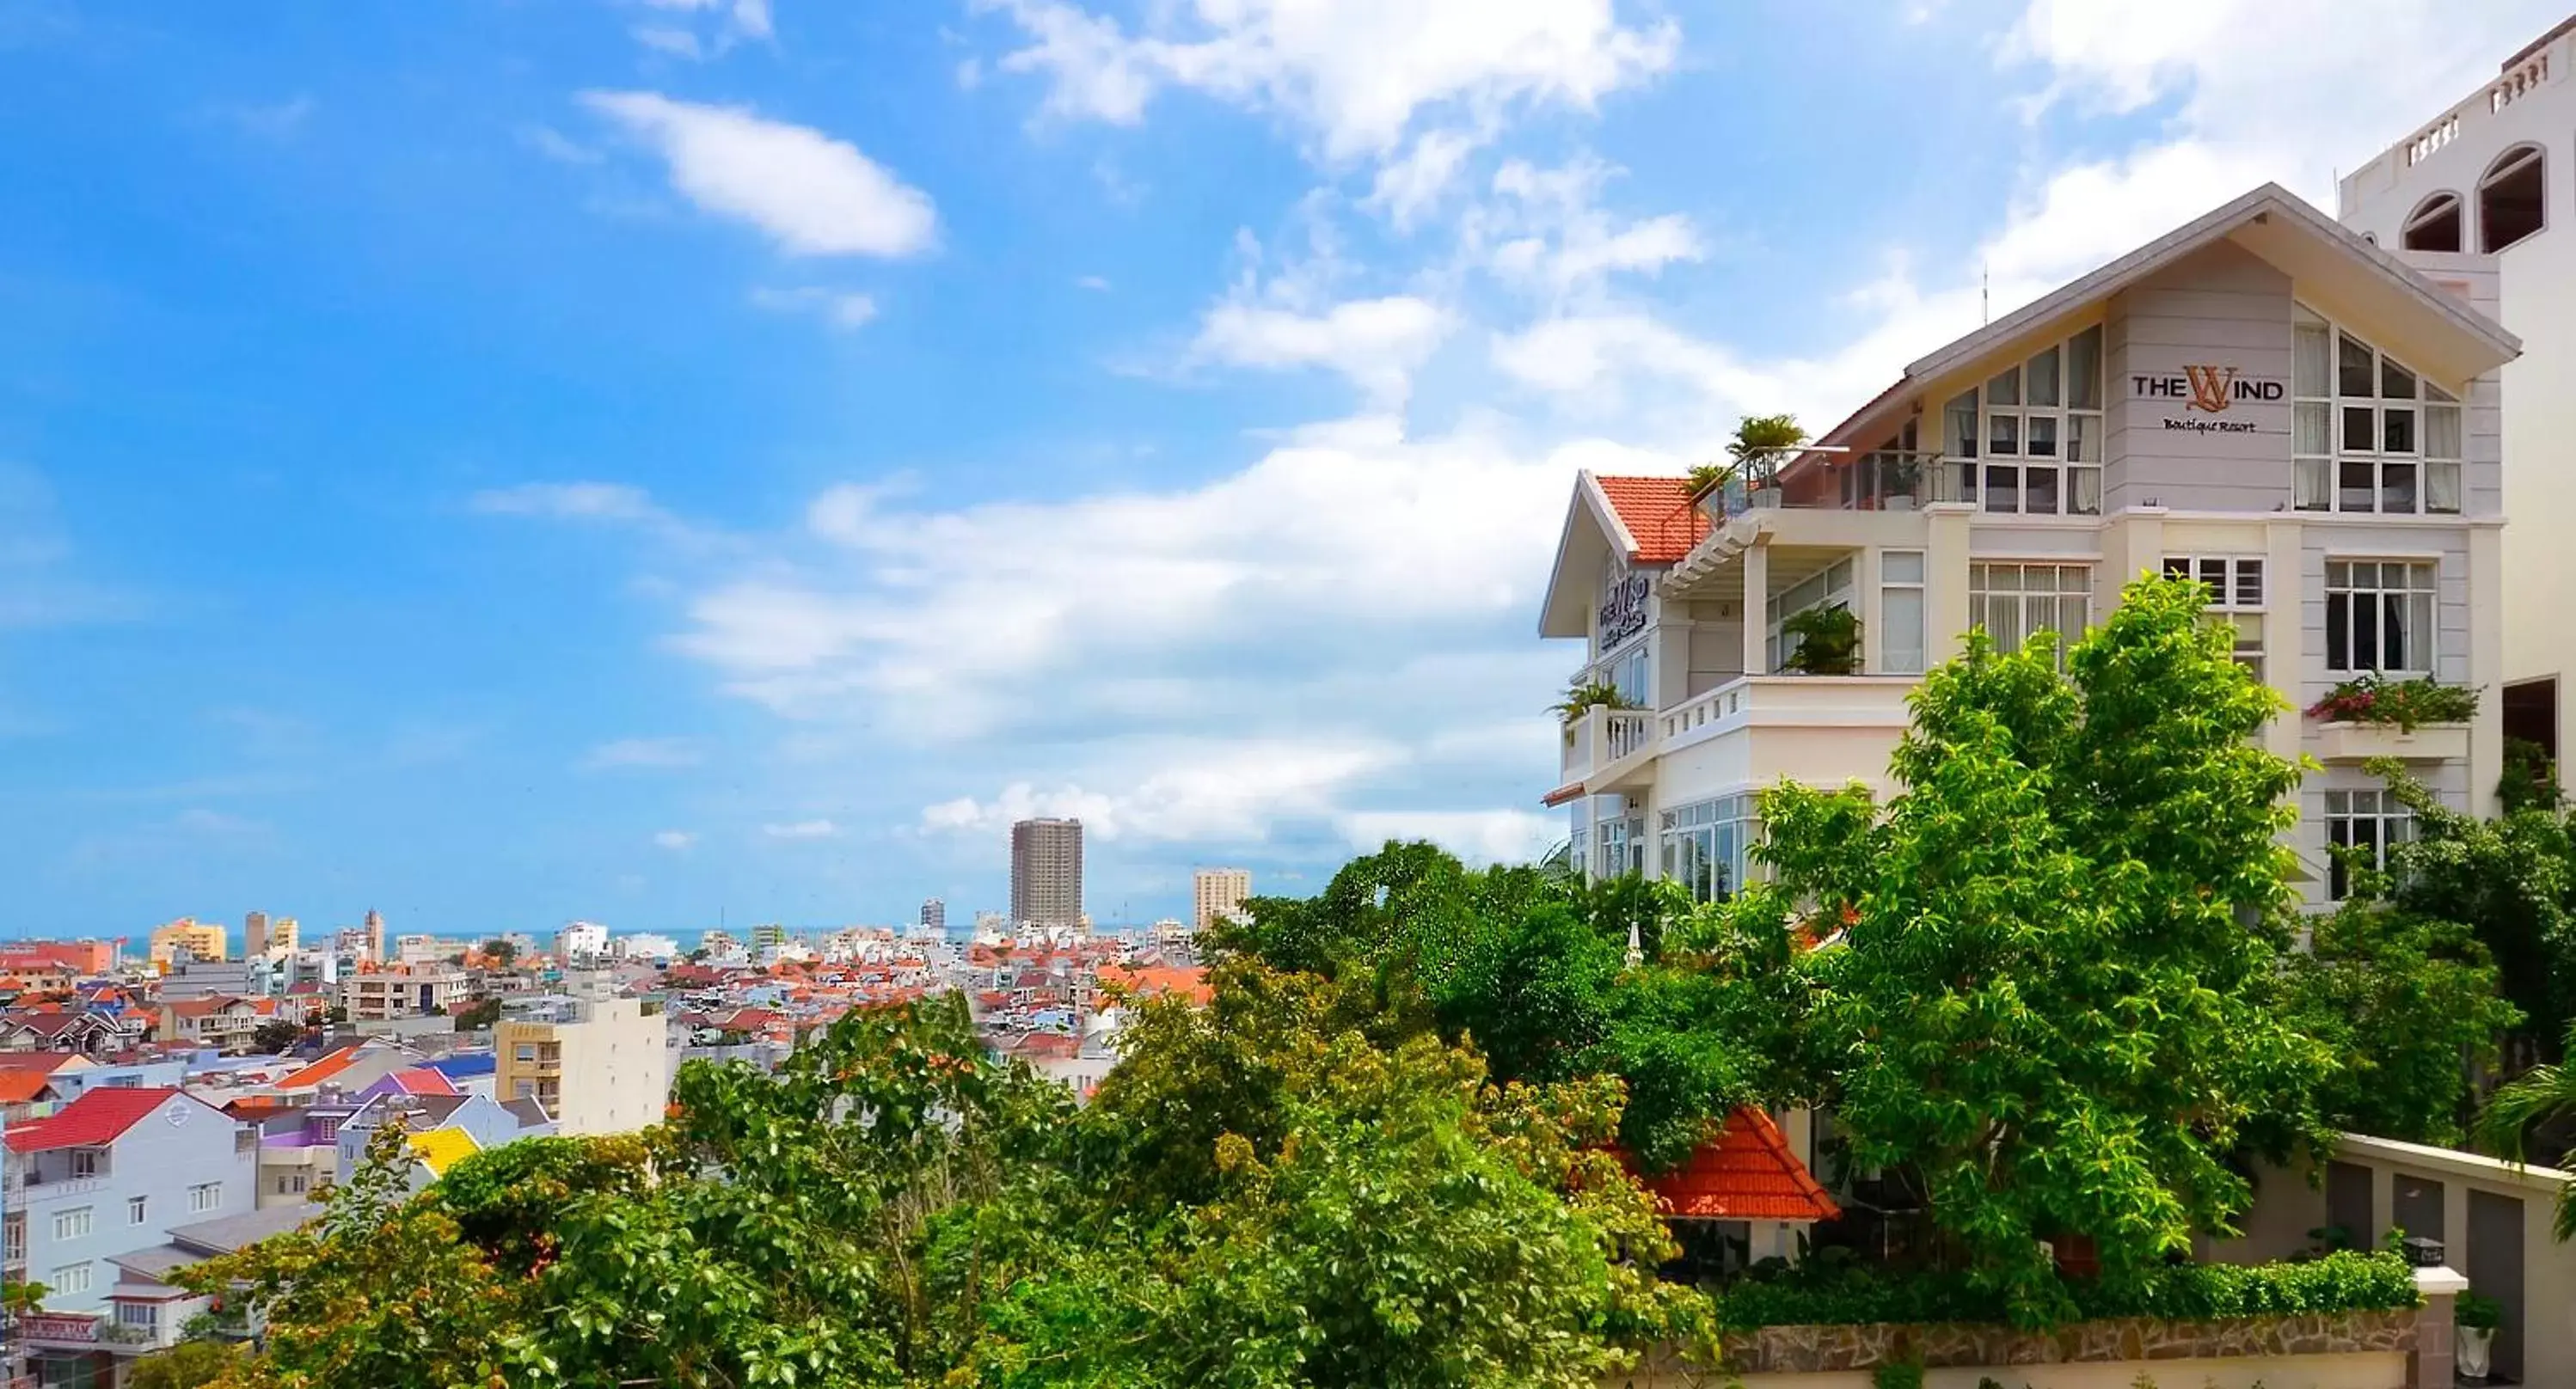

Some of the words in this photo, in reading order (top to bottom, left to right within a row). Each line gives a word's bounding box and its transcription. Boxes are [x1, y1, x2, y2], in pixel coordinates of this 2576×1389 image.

[2133, 376, 2187, 396] THE
[2183, 364, 2284, 413] WIND
[2163, 418, 2217, 436] Boutique
[2220, 422, 2257, 433] Resort
